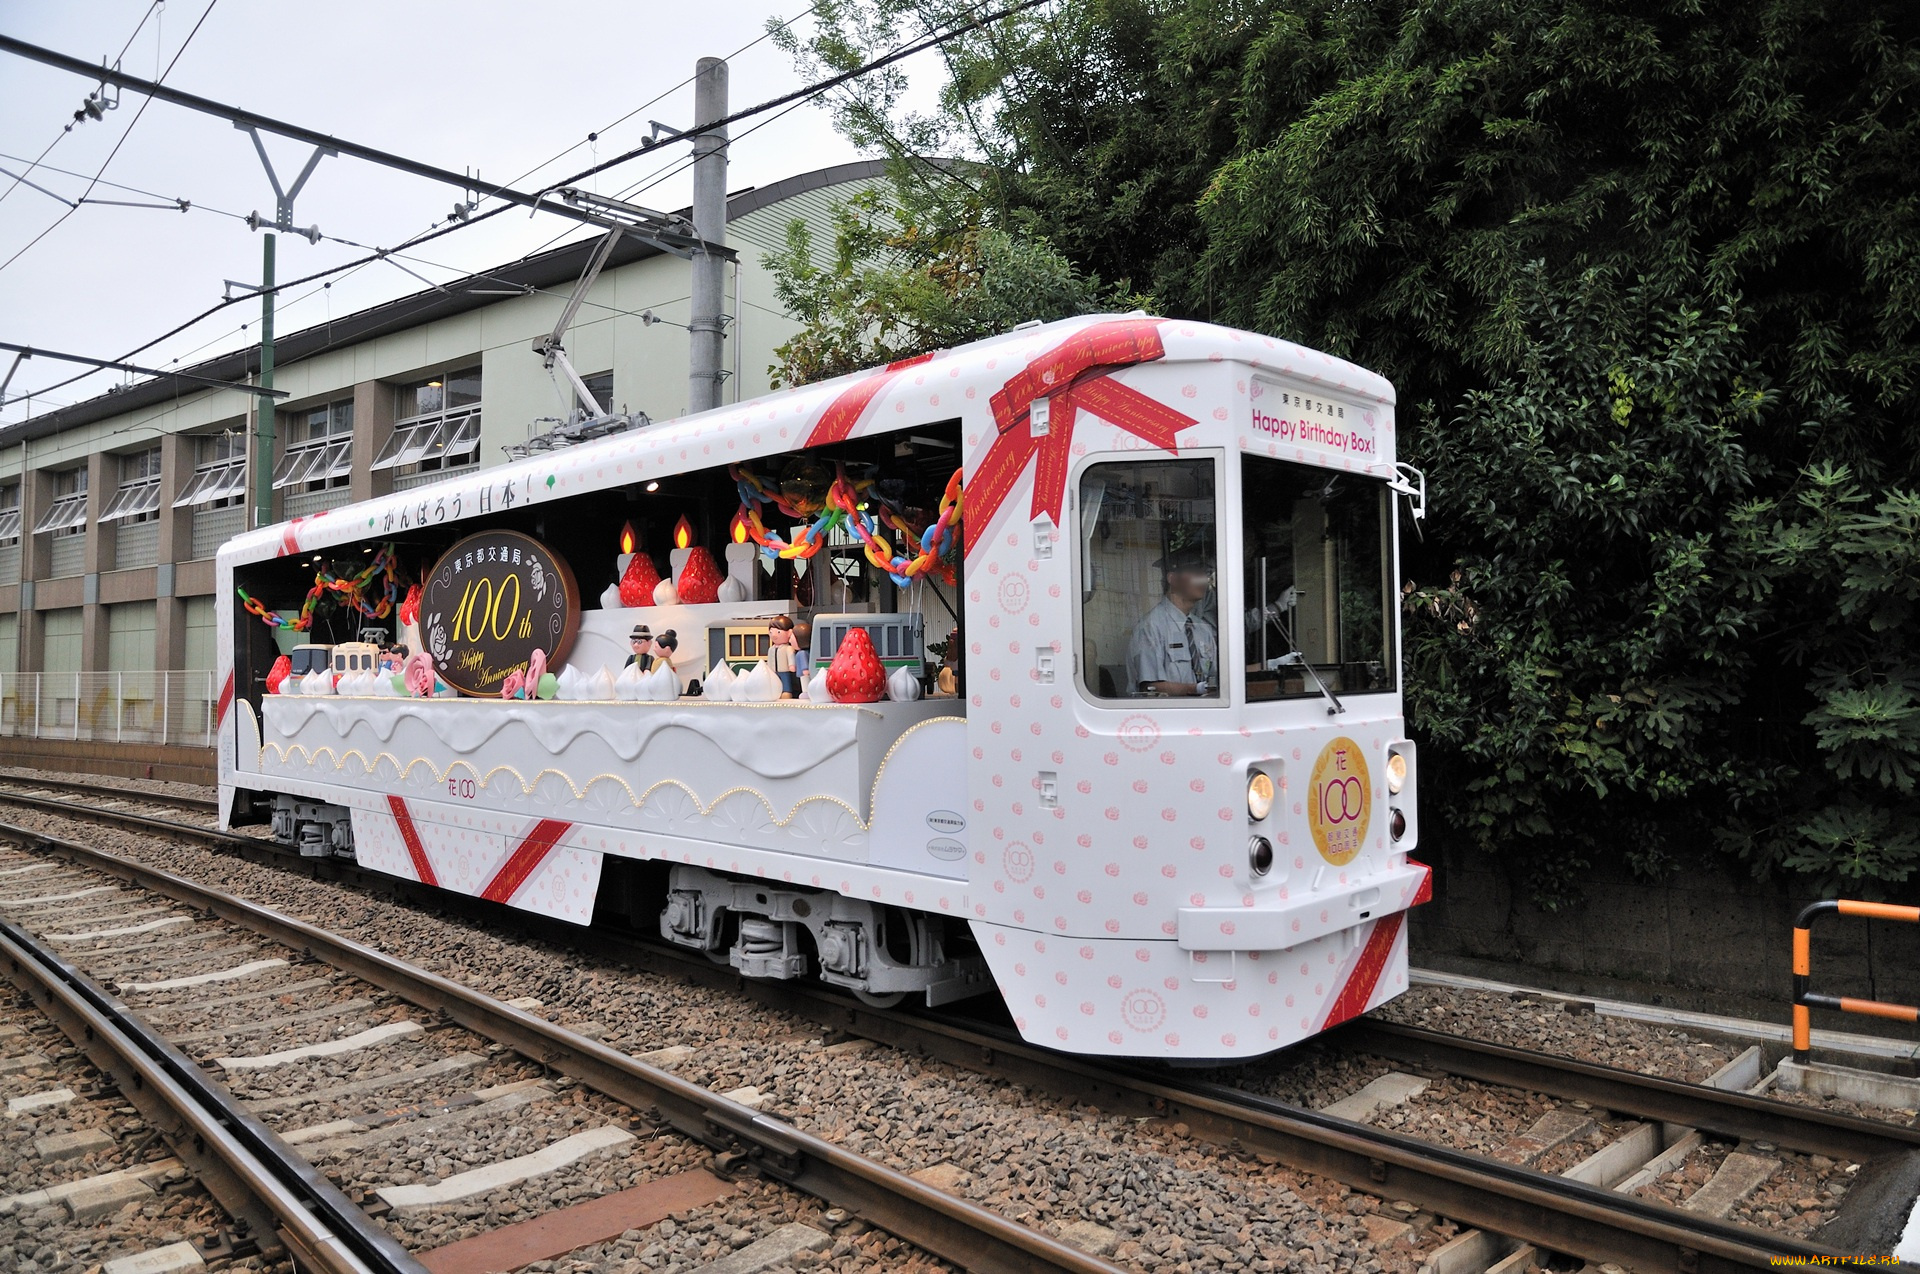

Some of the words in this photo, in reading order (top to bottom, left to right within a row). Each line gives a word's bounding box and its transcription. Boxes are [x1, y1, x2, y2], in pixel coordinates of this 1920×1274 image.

[1034, 361, 1065, 385] Hppy
[1081, 384, 1111, 406] Happy
[1112, 401, 1169, 434] Anniversary
[1282, 393, 1344, 419] 東京都交通局
[1252, 408, 1297, 442] Happy
[1300, 419, 1349, 453] Birthday
[1351, 431, 1376, 455] Box!
[384, 492, 462, 532] がんばろう
[454, 546, 522, 574] 東京都交通局
[456, 647, 485, 672] Happy
[1319, 776, 1363, 825] 100
